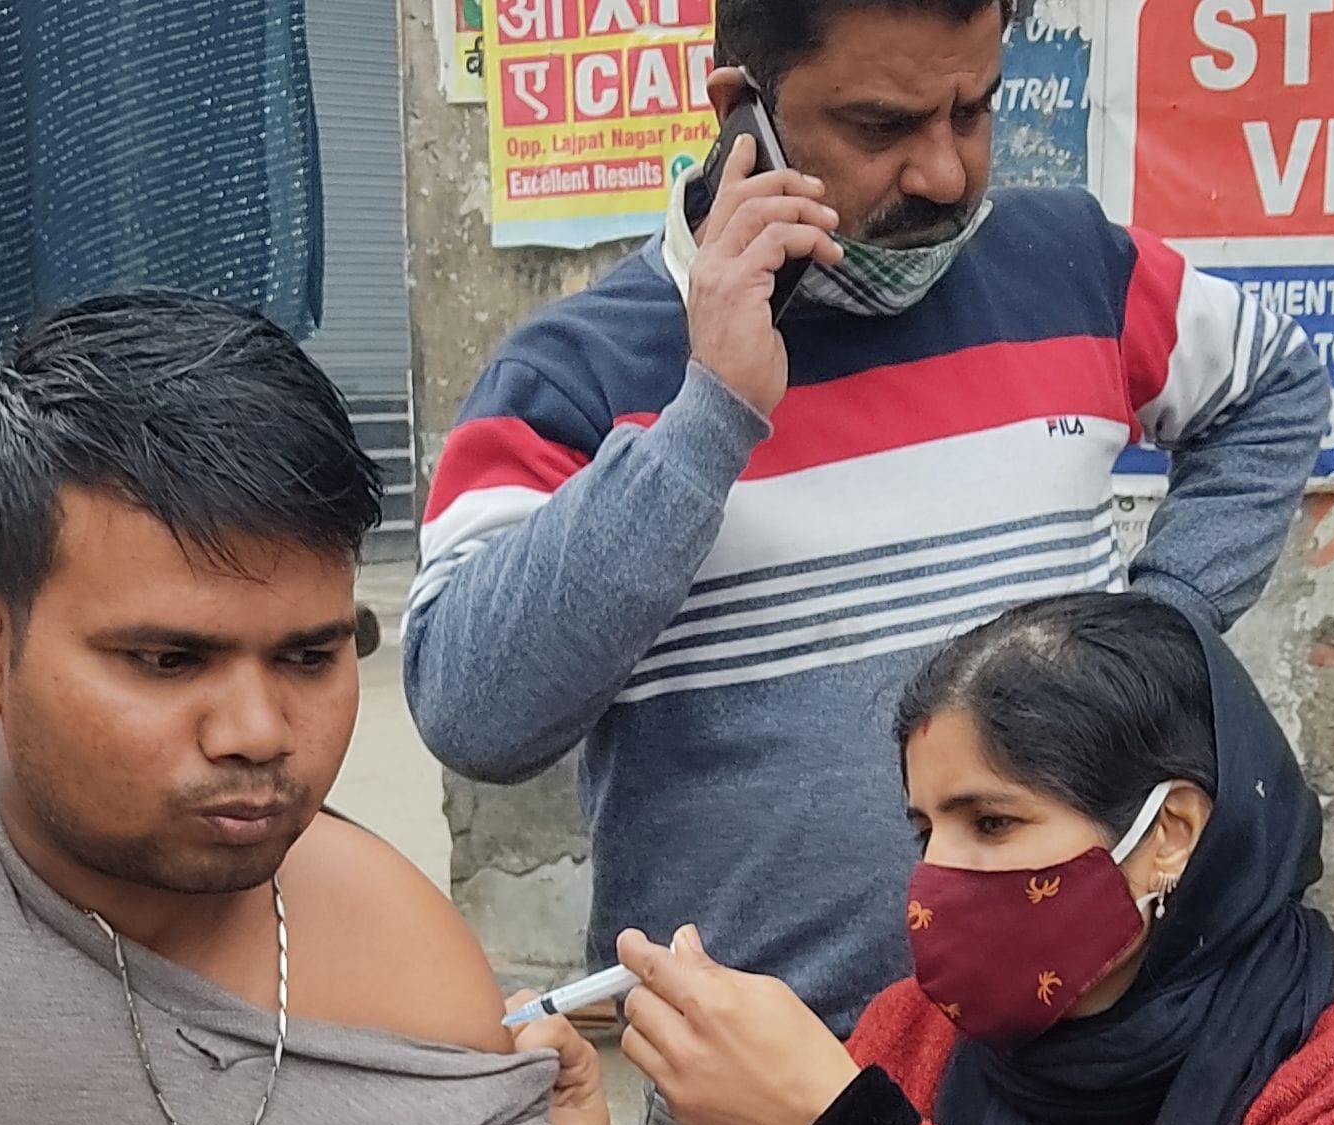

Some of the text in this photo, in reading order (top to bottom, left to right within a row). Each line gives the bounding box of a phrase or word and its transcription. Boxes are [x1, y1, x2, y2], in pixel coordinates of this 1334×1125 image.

[507, 136, 546, 159] Opp.
[553, 132, 605, 155] Lajpat
[612, 126, 666, 148] Nagar
[509, 161, 662, 197] Excellent Results
[1046, 415, 1085, 437] FILA
